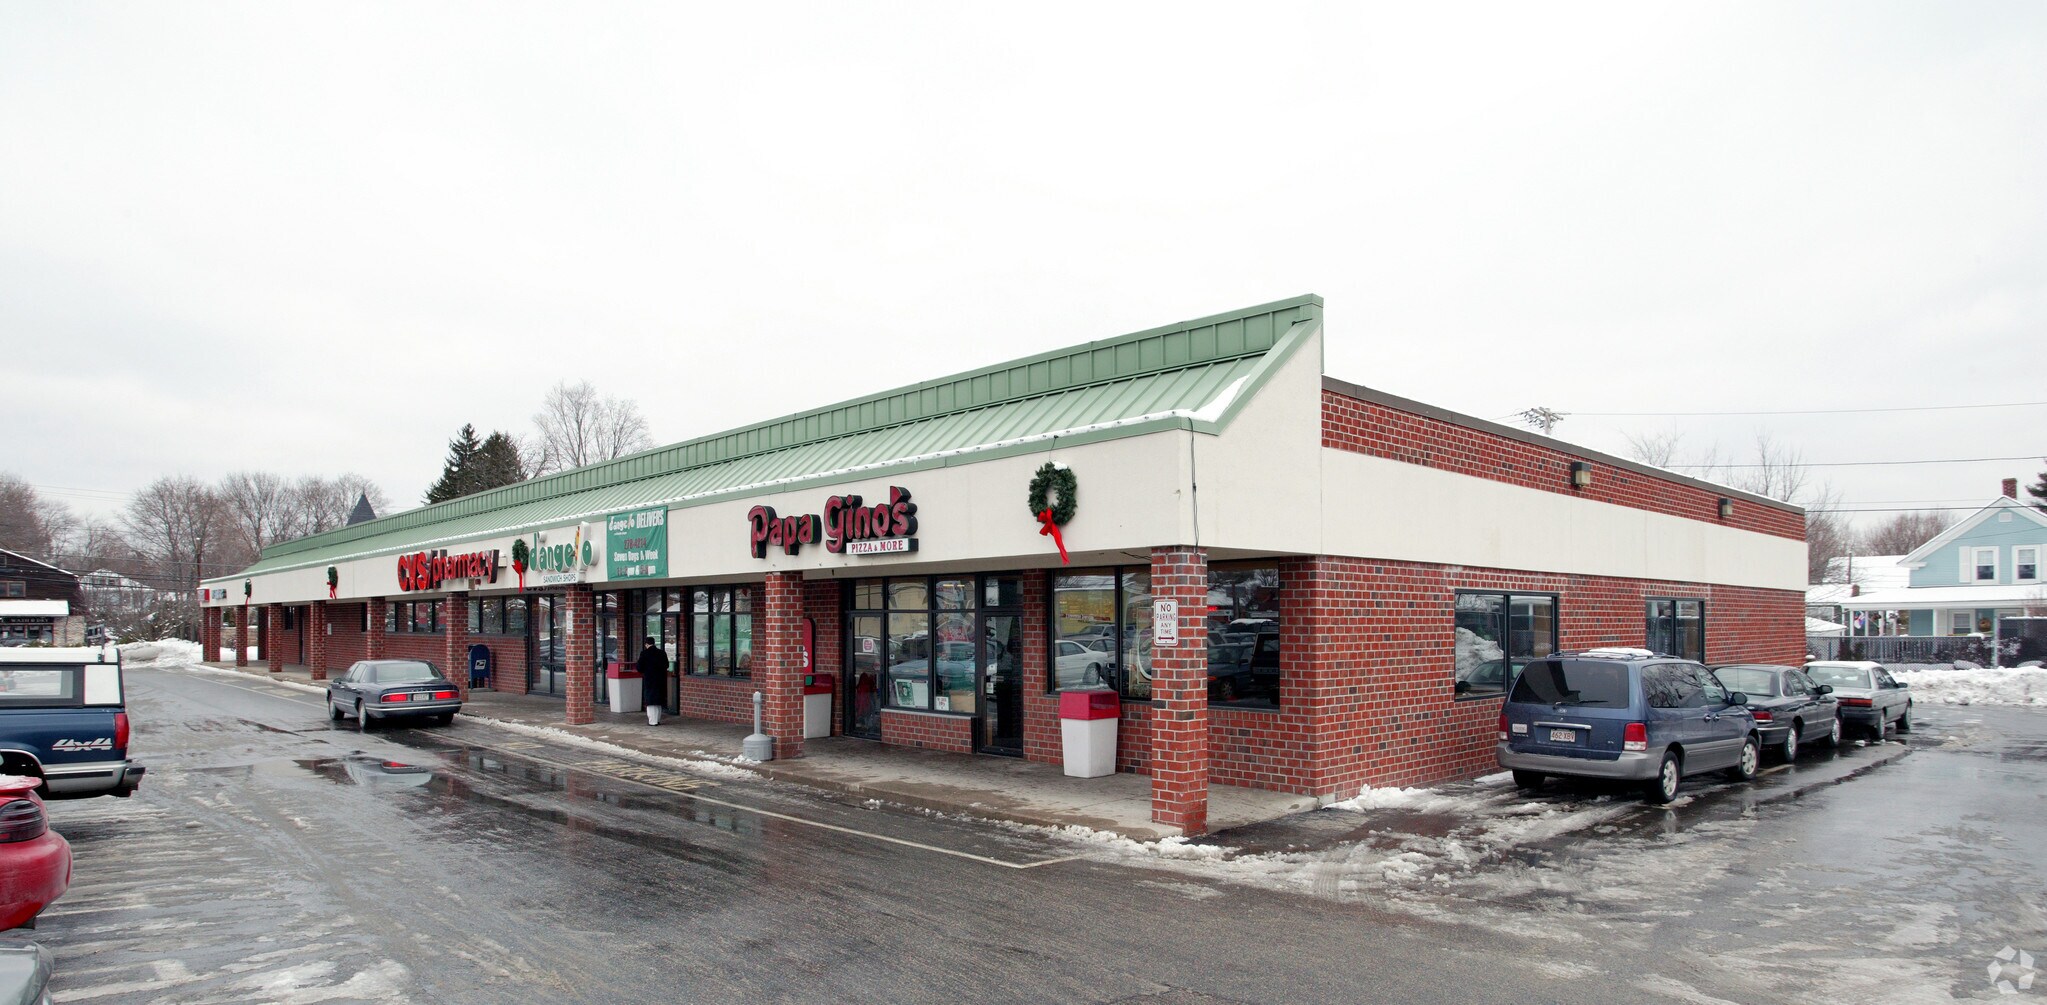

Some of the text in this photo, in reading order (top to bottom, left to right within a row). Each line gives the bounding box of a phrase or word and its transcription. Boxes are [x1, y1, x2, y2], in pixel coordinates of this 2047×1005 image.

[636, 509, 664, 528] DELIVERS
[748, 486, 917, 559] Papa Gino's
[851, 543, 873, 554] PIZZA
[880, 541, 904, 552] MORE
[397, 549, 499, 592] CVS/pharmacy
[543, 573, 576, 583] SANDWICH SHOPS
[1161, 604, 1171, 612] NO
[1156, 613, 1176, 621] PARKING
[52, 737, 113, 751] 4x4
